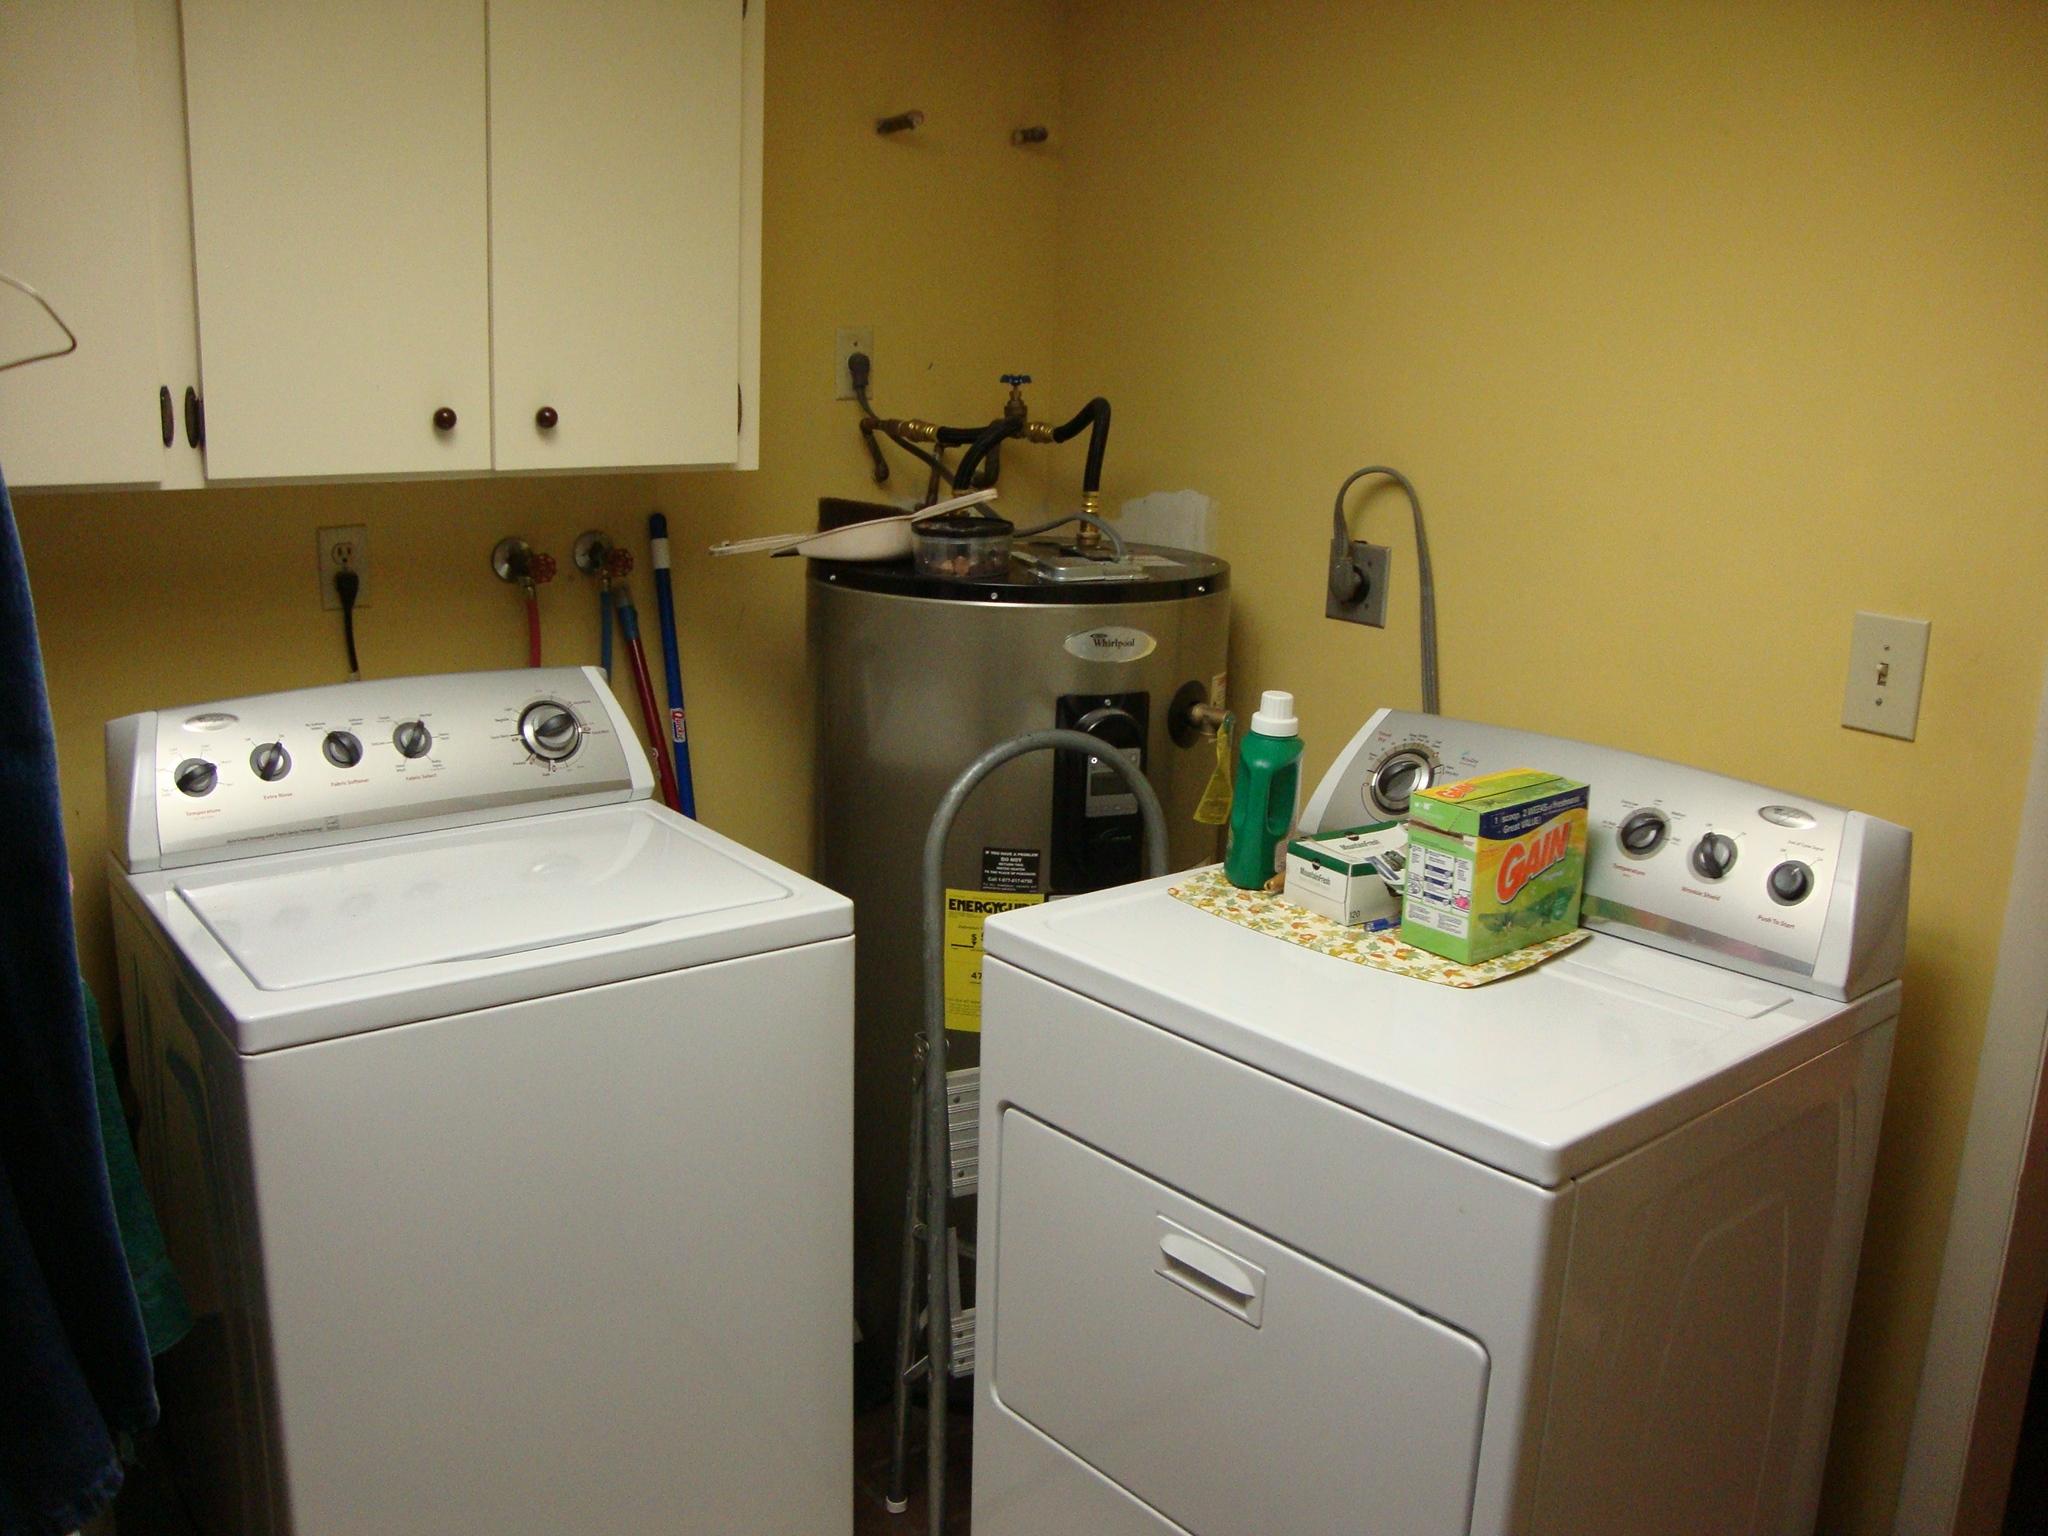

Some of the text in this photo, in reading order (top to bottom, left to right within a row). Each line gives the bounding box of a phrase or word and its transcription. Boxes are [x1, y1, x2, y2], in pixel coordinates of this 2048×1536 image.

[1092, 638, 1136, 649] Whirlpool
[1497, 821, 1570, 903] GAIN
[1757, 914, 1771, 923] Push
[1781, 919, 1795, 929] Start
